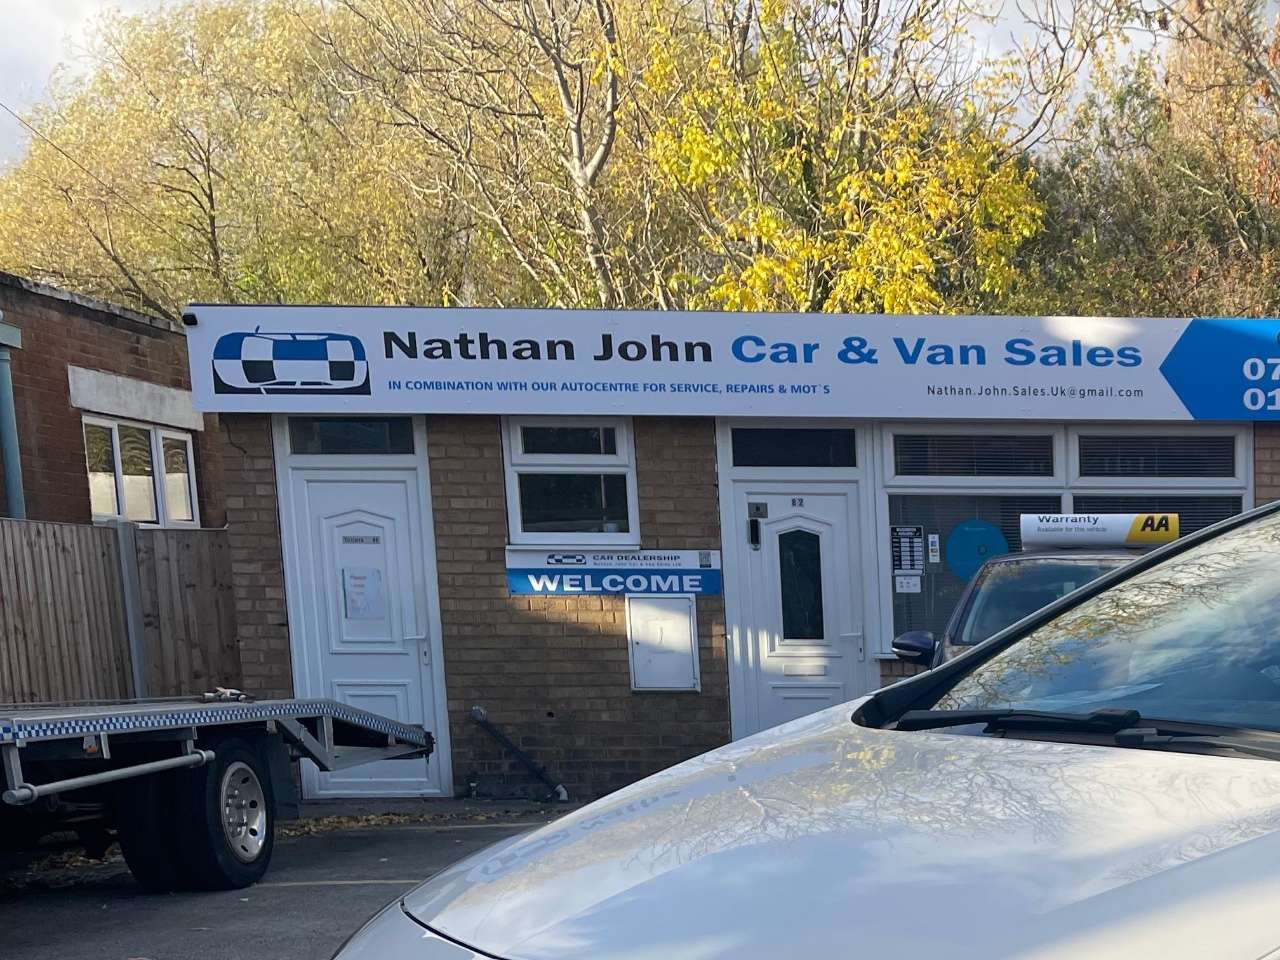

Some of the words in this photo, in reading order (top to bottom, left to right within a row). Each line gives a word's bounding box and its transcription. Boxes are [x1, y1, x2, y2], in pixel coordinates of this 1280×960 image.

[383, 331, 575, 361] Nathan
[594, 333, 712, 362] John
[731, 335, 820, 364] Car
[837, 336, 878, 364] &
[893, 337, 986, 366] Van
[1004, 338, 1143, 367] Sales
[388, 380, 401, 391] IN
[405, 380, 494, 391] COMBINATION
[497, 381, 528, 391] WITH
[531, 381, 558, 392] OUR
[561, 382, 640, 393] AUTOCENTRE
[643, 383, 667, 393] FOR
[670, 383, 723, 394] SERVICE,
[726, 384, 775, 394] REPAIRS
[778, 384, 787, 394] &
[927, 385, 1144, 399] Nathan.John.Sales.Uk@gmail.com
[1038, 515, 1100, 525] Warranty
[1140, 515, 1169, 532] AA
[527, 574, 702, 592] WELCOME
